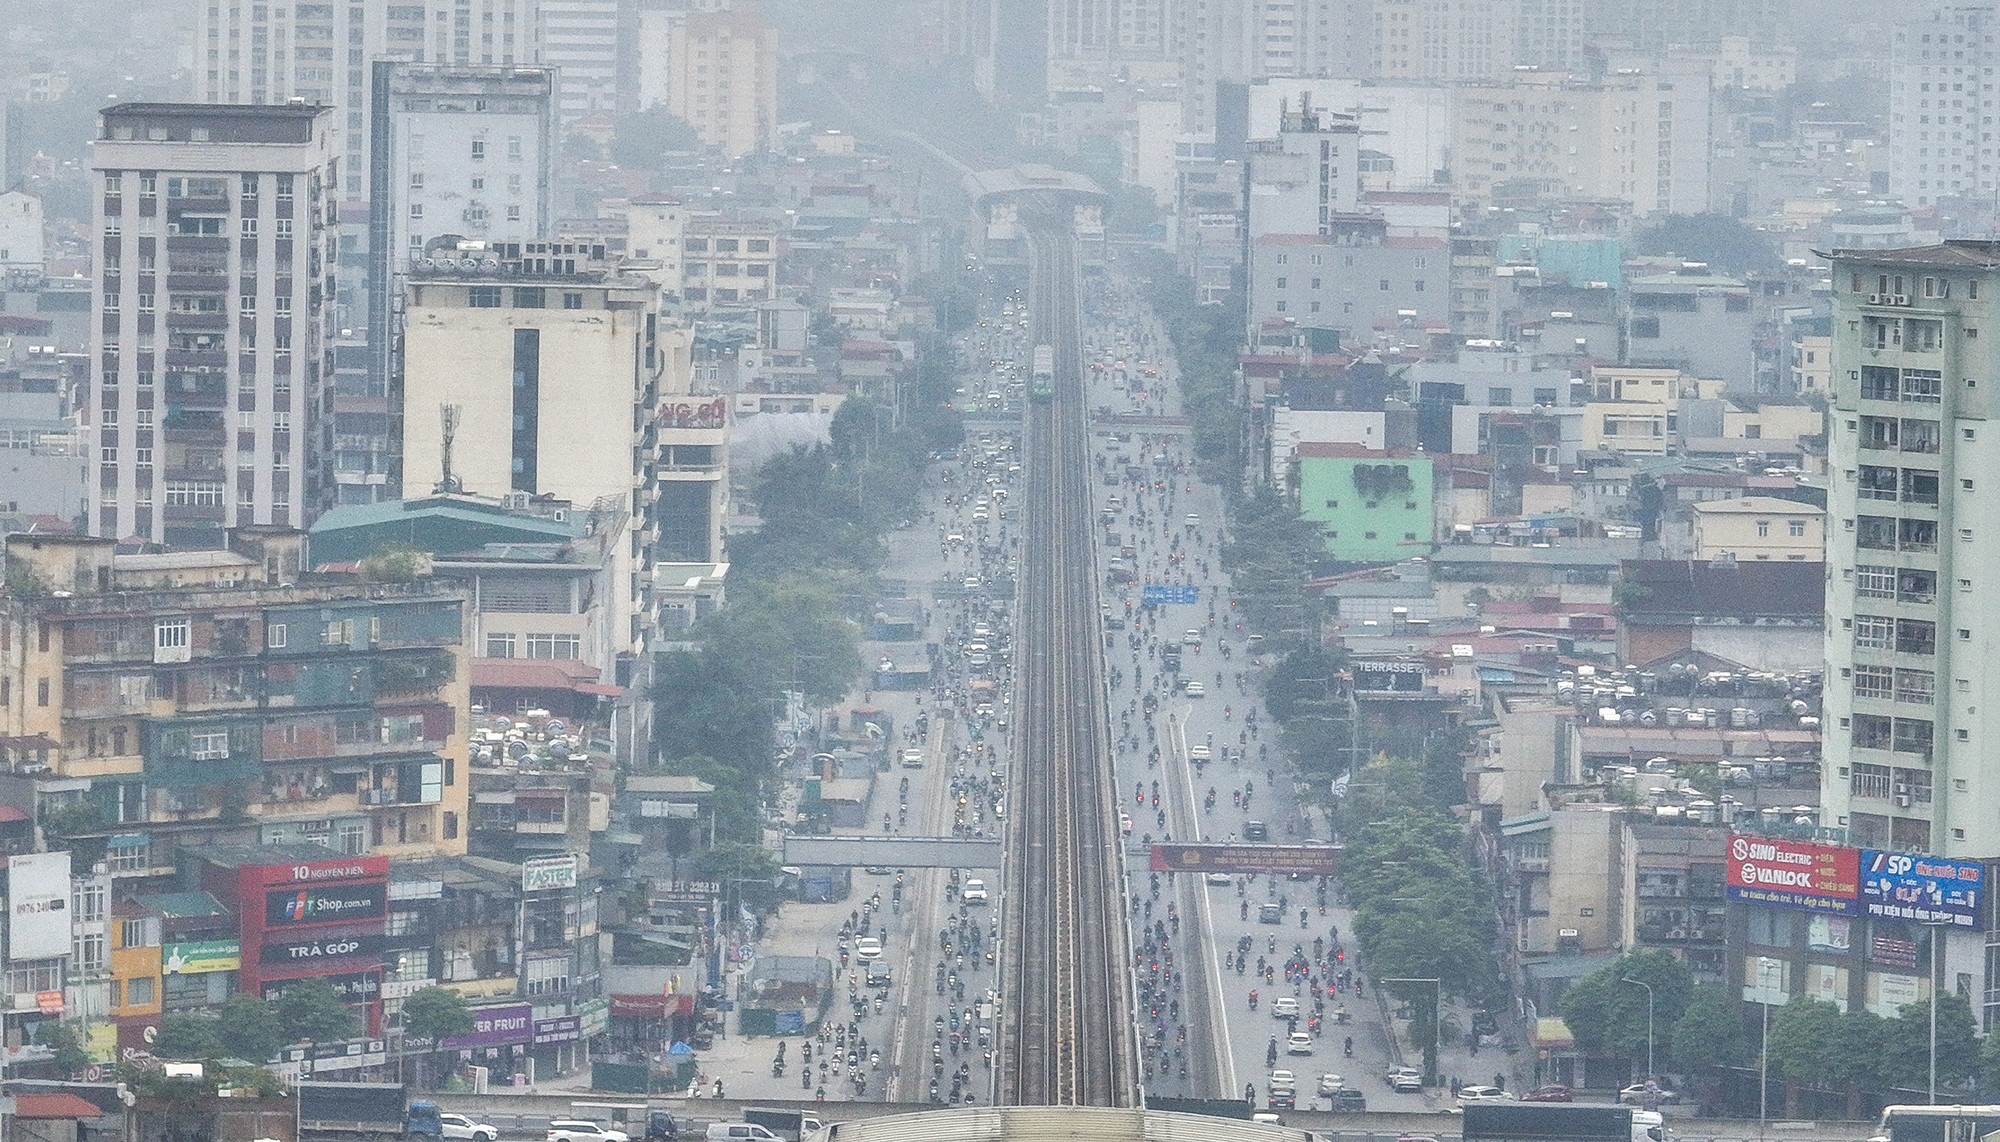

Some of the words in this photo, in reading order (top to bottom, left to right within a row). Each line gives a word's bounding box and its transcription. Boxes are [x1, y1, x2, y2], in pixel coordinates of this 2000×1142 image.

[1360, 662, 1415, 674] TERRASSE
[1749, 843, 1775, 861] SINO
[1777, 852, 1812, 866] ELECTRIC
[292, 866, 309, 879] 10
[1888, 855, 1912, 875] SP
[1757, 867, 1812, 888] VANLOCK
[317, 898, 371, 912] Shop.com.vn
[325, 939, 359, 955] GÓP
[494, 1017, 526, 1031] FRUIT
